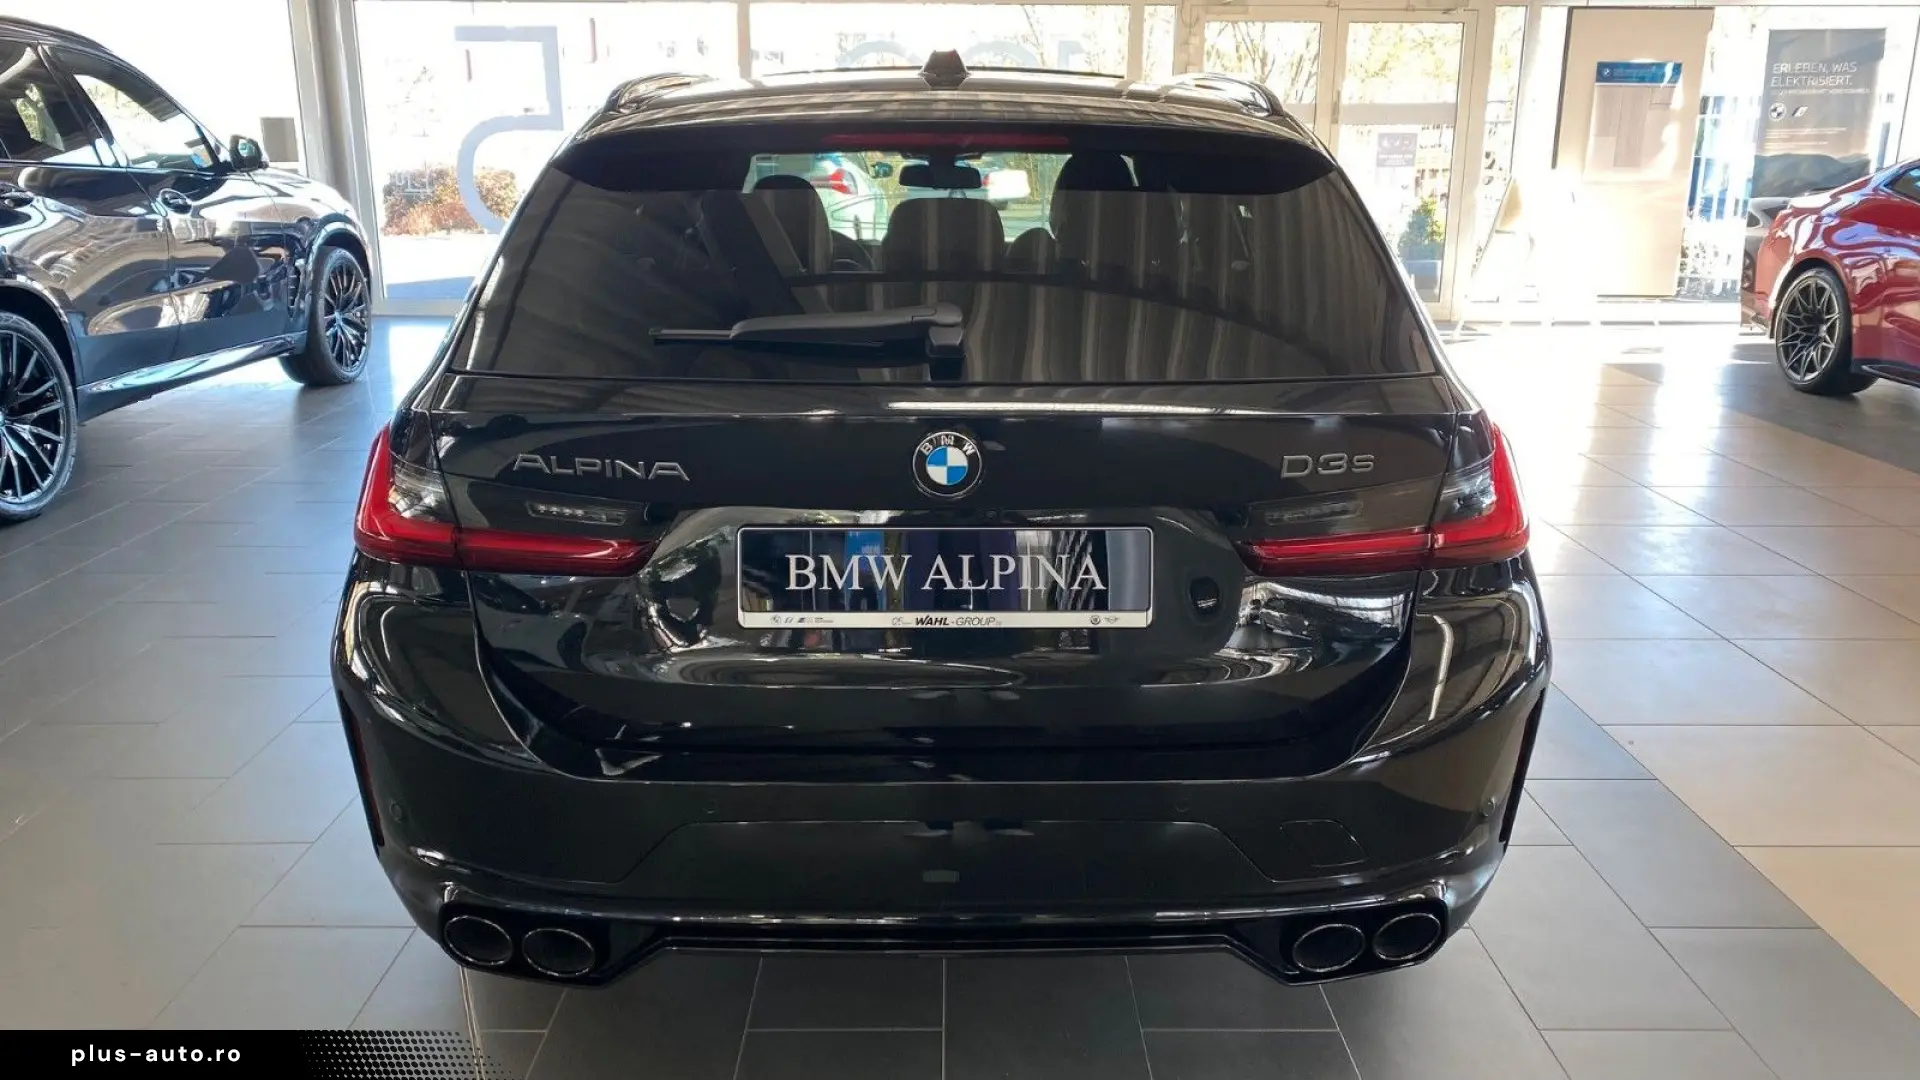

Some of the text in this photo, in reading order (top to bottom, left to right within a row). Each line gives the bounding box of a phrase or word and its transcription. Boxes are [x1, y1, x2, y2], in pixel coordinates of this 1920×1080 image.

[1772, 61, 1858, 75] ERLEBEN, WAS
[1770, 75, 1854, 88] ELEKTRISIERT.
[920, 435, 976, 456] BMW
[512, 453, 691, 482] ALPINA
[785, 554, 1107, 590] BMW ALPINA
